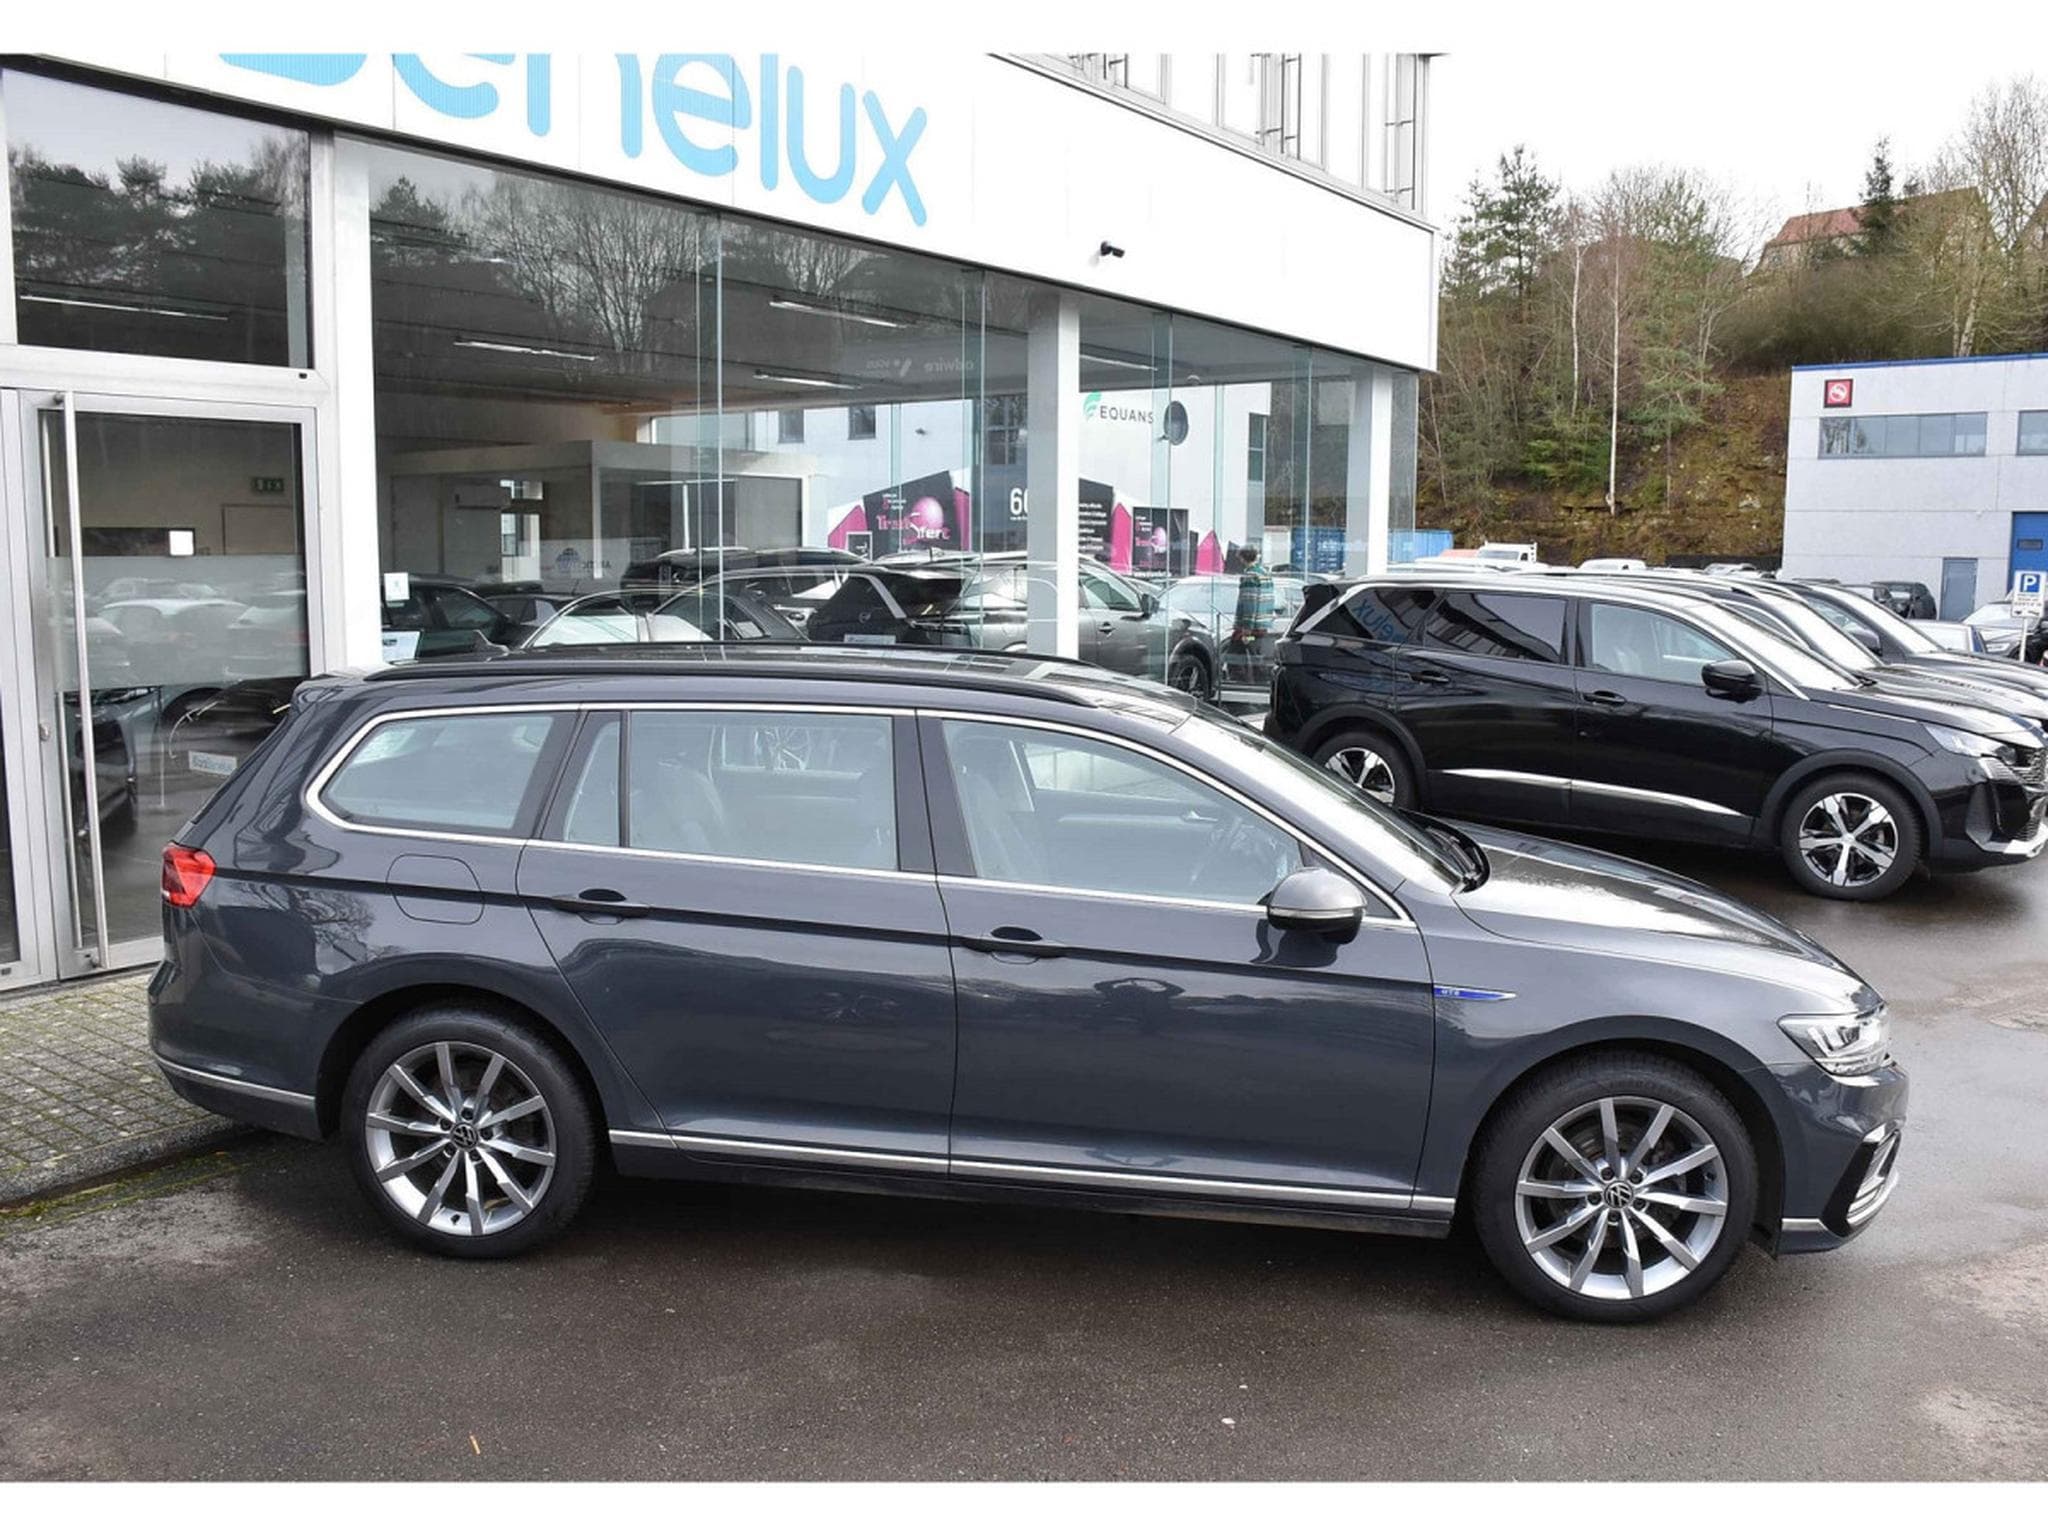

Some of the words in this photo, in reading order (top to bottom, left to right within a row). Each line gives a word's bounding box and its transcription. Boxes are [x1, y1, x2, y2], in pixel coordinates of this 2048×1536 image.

[219, 53, 928, 227] nelux
[1099, 405, 1155, 424] EQUANS
[2023, 575, 2037, 591] P
